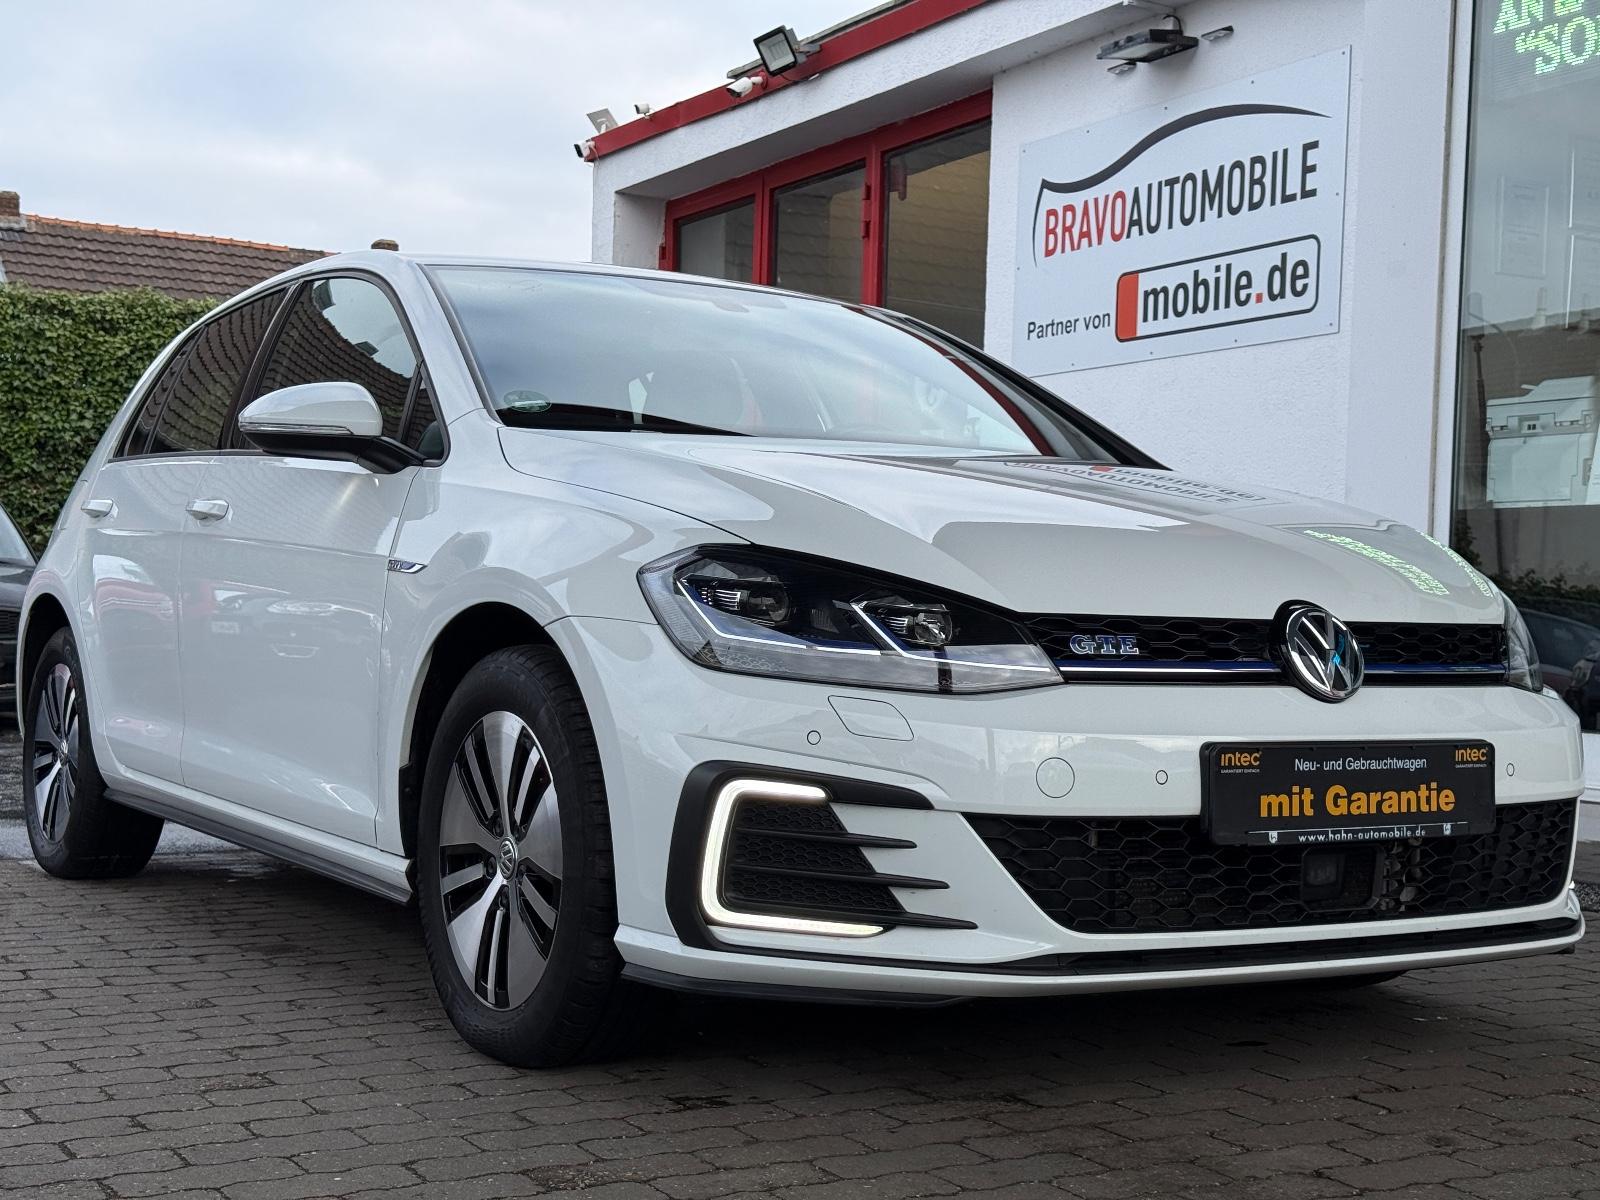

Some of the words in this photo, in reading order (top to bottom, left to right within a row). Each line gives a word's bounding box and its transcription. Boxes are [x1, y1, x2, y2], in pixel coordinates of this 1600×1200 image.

[1044, 140, 1320, 258] BRAVOAUTOMOBILE
[1142, 252, 1310, 322] mobile.de
[1027, 319, 1079, 341] Partner
[1083, 313, 1111, 330] von
[1069, 634, 1140, 656] GTE
[1220, 751, 1260, 767] intec
[1294, 759, 1321, 772] Neu-
[1323, 757, 1343, 770] und
[1345, 757, 1427, 771] Gebrauchtwagen
[1455, 747, 1487, 762] intec
[1260, 786, 1314, 818] mit
[1325, 781, 1456, 816] Garantie
[1298, 825, 1426, 843] www.hahn-automobile.de
